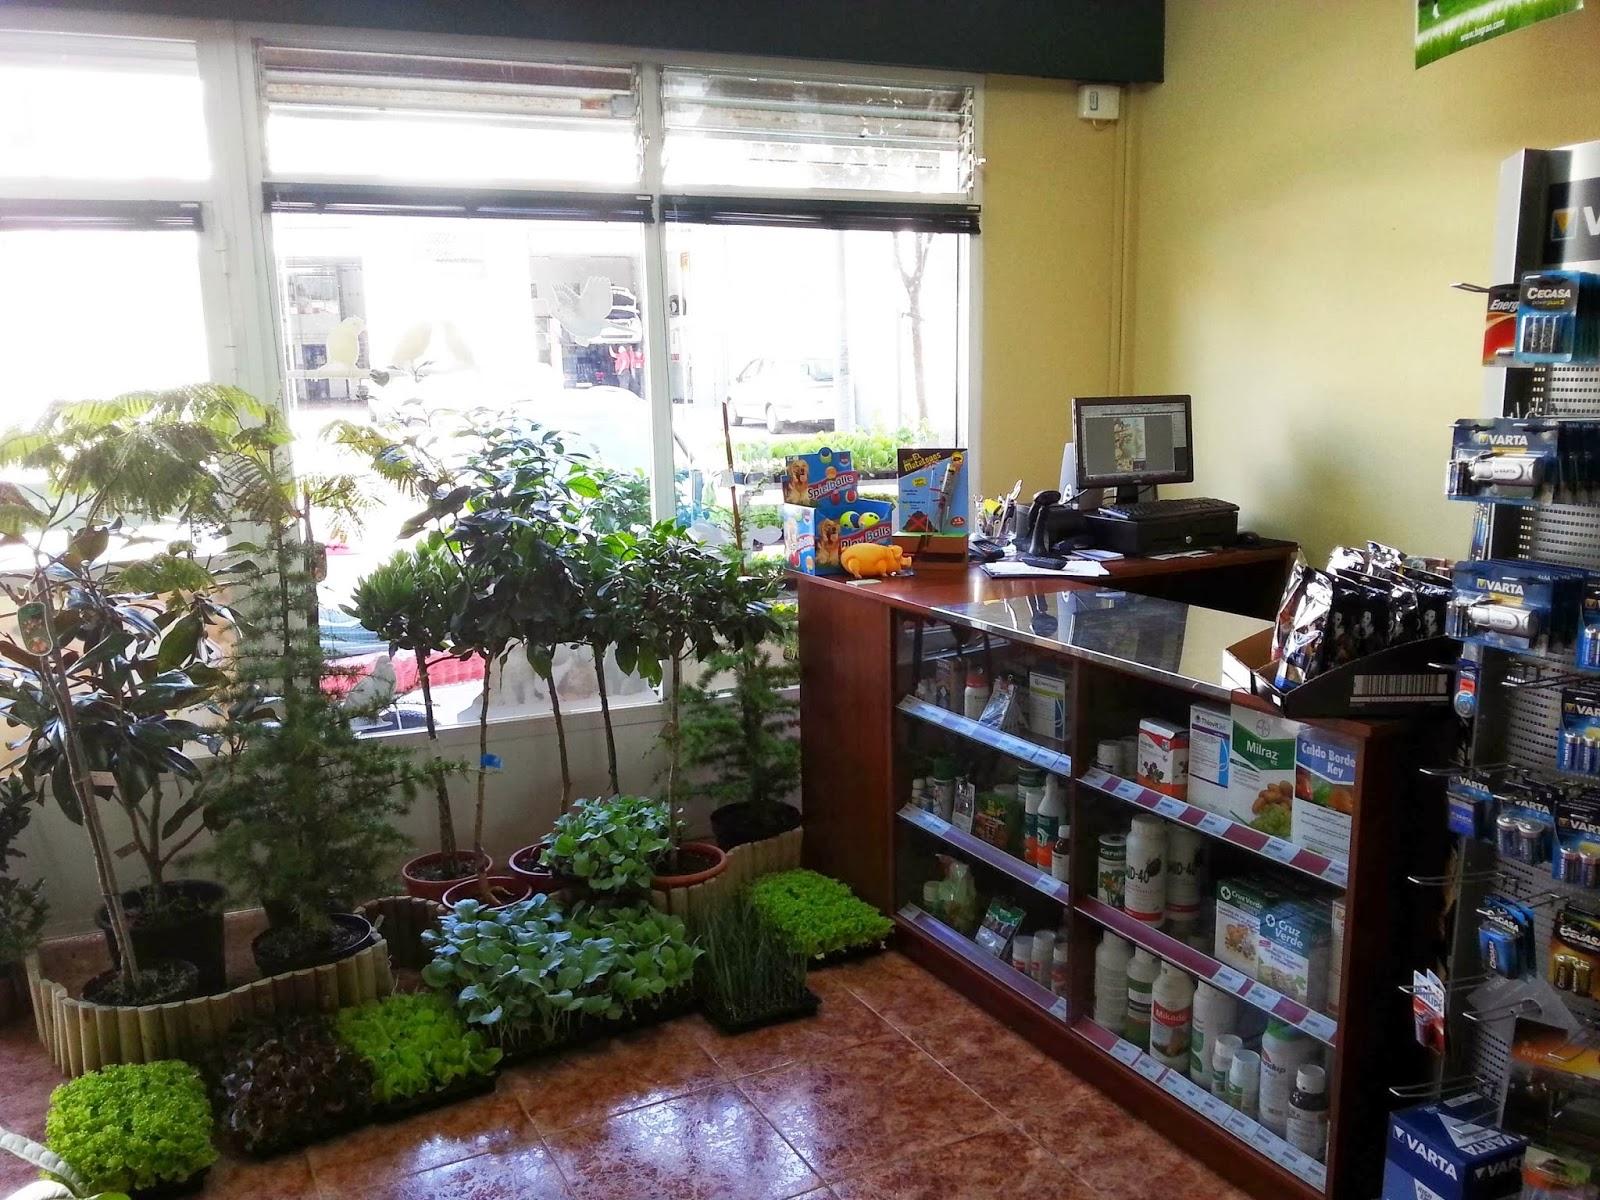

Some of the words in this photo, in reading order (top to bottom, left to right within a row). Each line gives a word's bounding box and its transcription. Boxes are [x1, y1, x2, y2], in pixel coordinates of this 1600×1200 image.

[1527, 288, 1572, 300] CEGASA
[1489, 299, 1519, 312] Energ
[1488, 434, 1528, 446] VARTA
[1486, 580, 1524, 596] VARTA
[1576, 704, 1600, 716] VAR
[1246, 740, 1278, 760] Milraz
[1301, 742, 1326, 759] Caldo
[1327, 762, 1344, 778] Key
[1459, 775, 1490, 793] VARTA
[1570, 820, 1600, 834] VART
[1278, 920, 1301, 938] Cruz
[1275, 928, 1304, 949] Verde
[1406, 1133, 1458, 1181] VARTA
[1487, 1155, 1522, 1177] VAR
